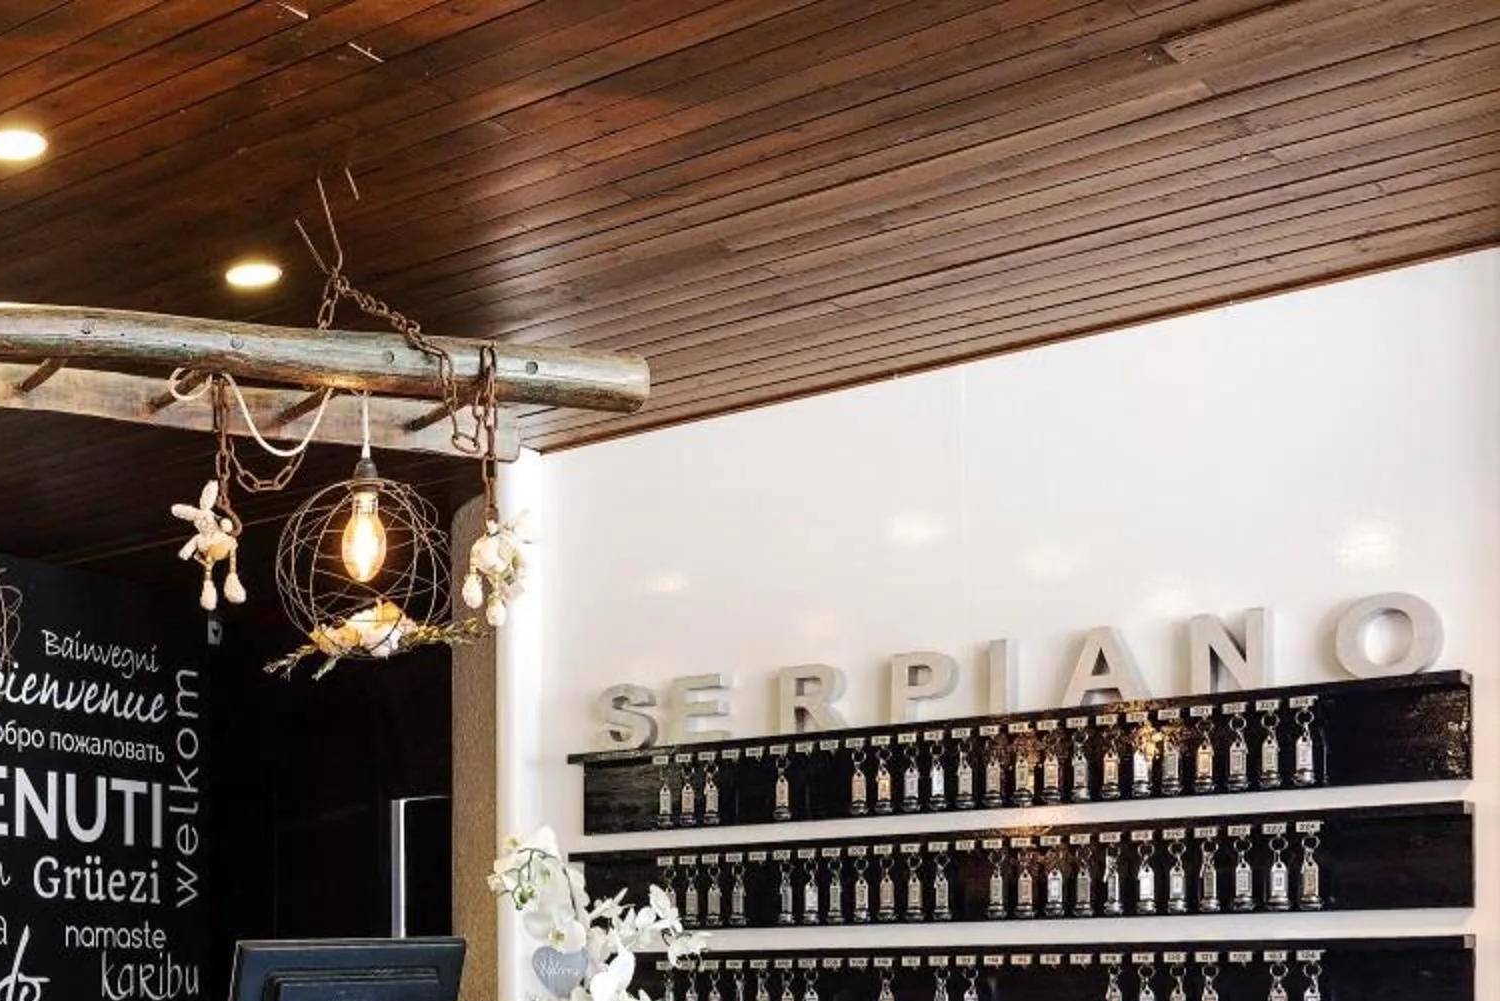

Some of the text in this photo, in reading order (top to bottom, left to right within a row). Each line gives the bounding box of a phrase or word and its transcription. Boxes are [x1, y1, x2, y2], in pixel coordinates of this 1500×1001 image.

[596, 591, 1444, 750] SERPIANO
[49, 731, 165, 763] пожаловать
[168, 669, 199, 908] welkom
[33, 855, 161, 904] Grüezi
[65, 920, 167, 949] namaste
